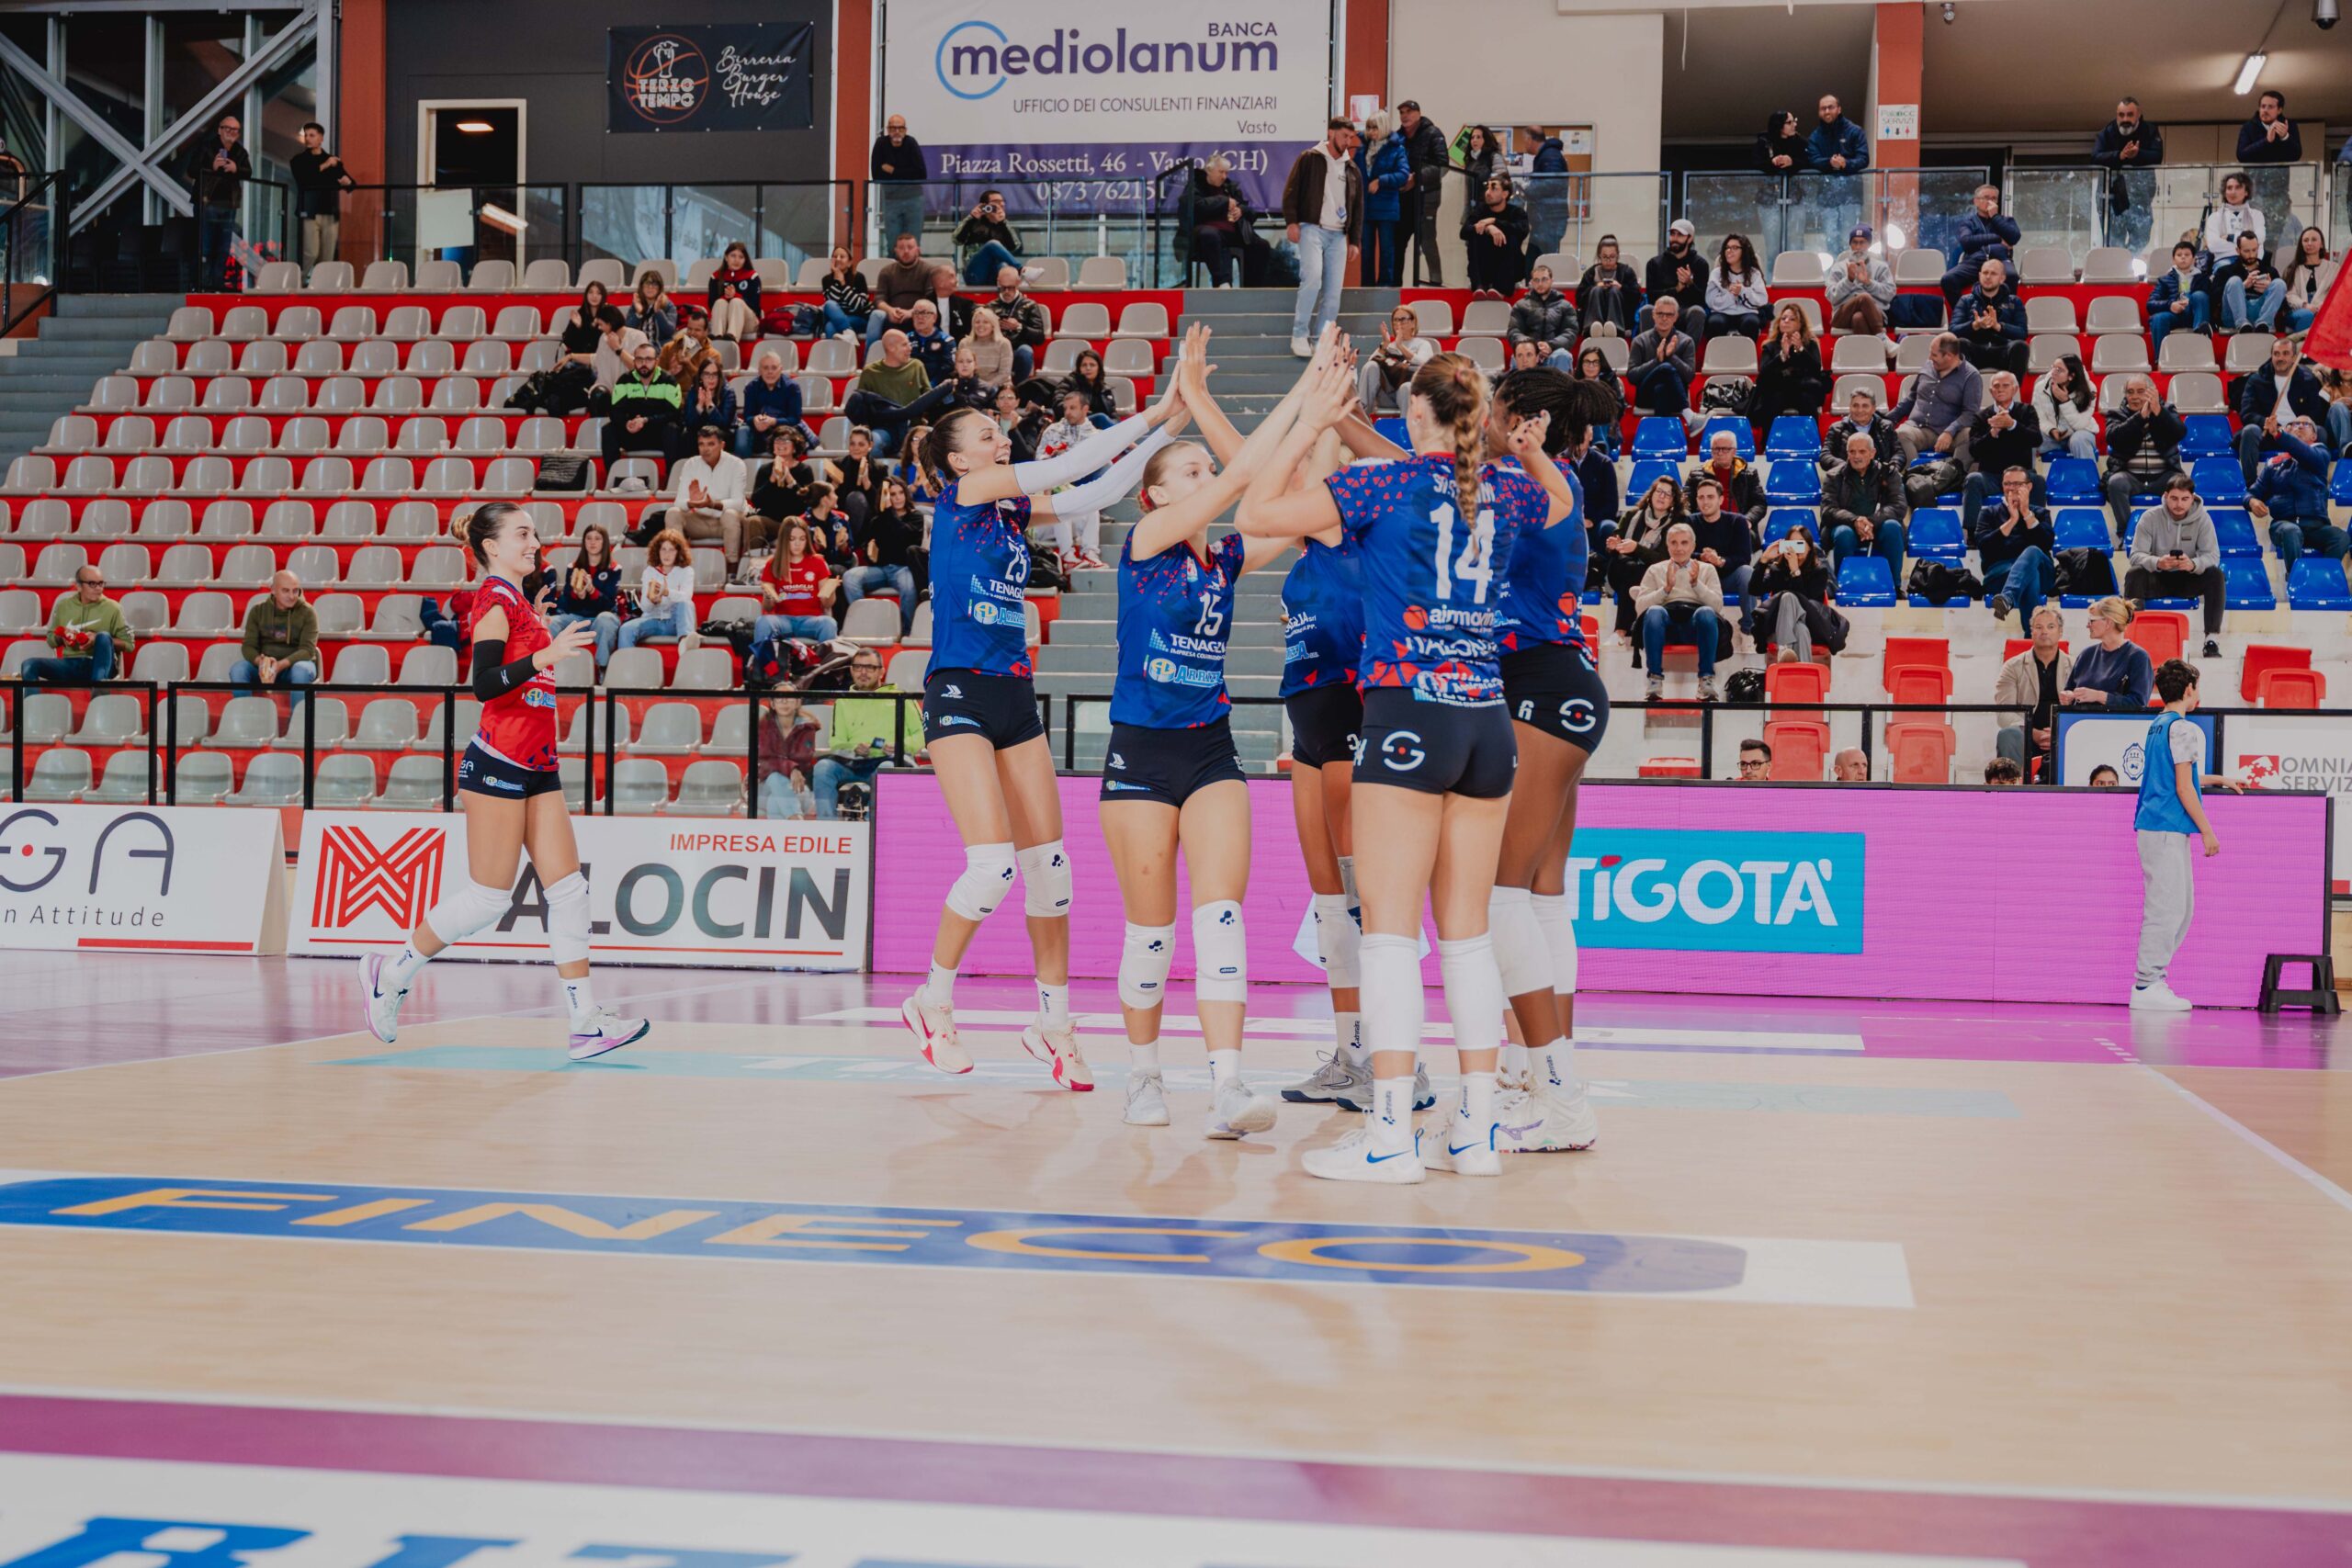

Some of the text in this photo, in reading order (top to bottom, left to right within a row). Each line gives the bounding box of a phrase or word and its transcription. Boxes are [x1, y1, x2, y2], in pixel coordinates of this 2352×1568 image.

[1208, 22, 1278, 37] BANCA
[716, 45, 797, 73] Birreria
[952, 28, 1278, 75] mediolanum
[639, 78, 695, 93] TERZO
[722, 63, 789, 93] Burger
[639, 93, 695, 108] TEMPO
[729, 81, 781, 108] House
[1013, 96, 1277, 114] UFFICIO DEI CONSULENTI FINANZIARI
[1237, 120, 1277, 135] Vasto
[941, 152, 1002, 175] Piazza
[1008, 151, 1095, 176] Rossetti,
[1101, 152, 1126, 172] 46
[1036, 181, 1088, 201] 0873
[1005, 542, 1027, 583] 25
[1430, 502, 1497, 604] 14
[1195, 592, 1224, 637] 15
[670, 832, 853, 854] IMPRESA EDILE
[30, 905, 164, 928] Attitude
[50, 1188, 1588, 1273] FINECO
